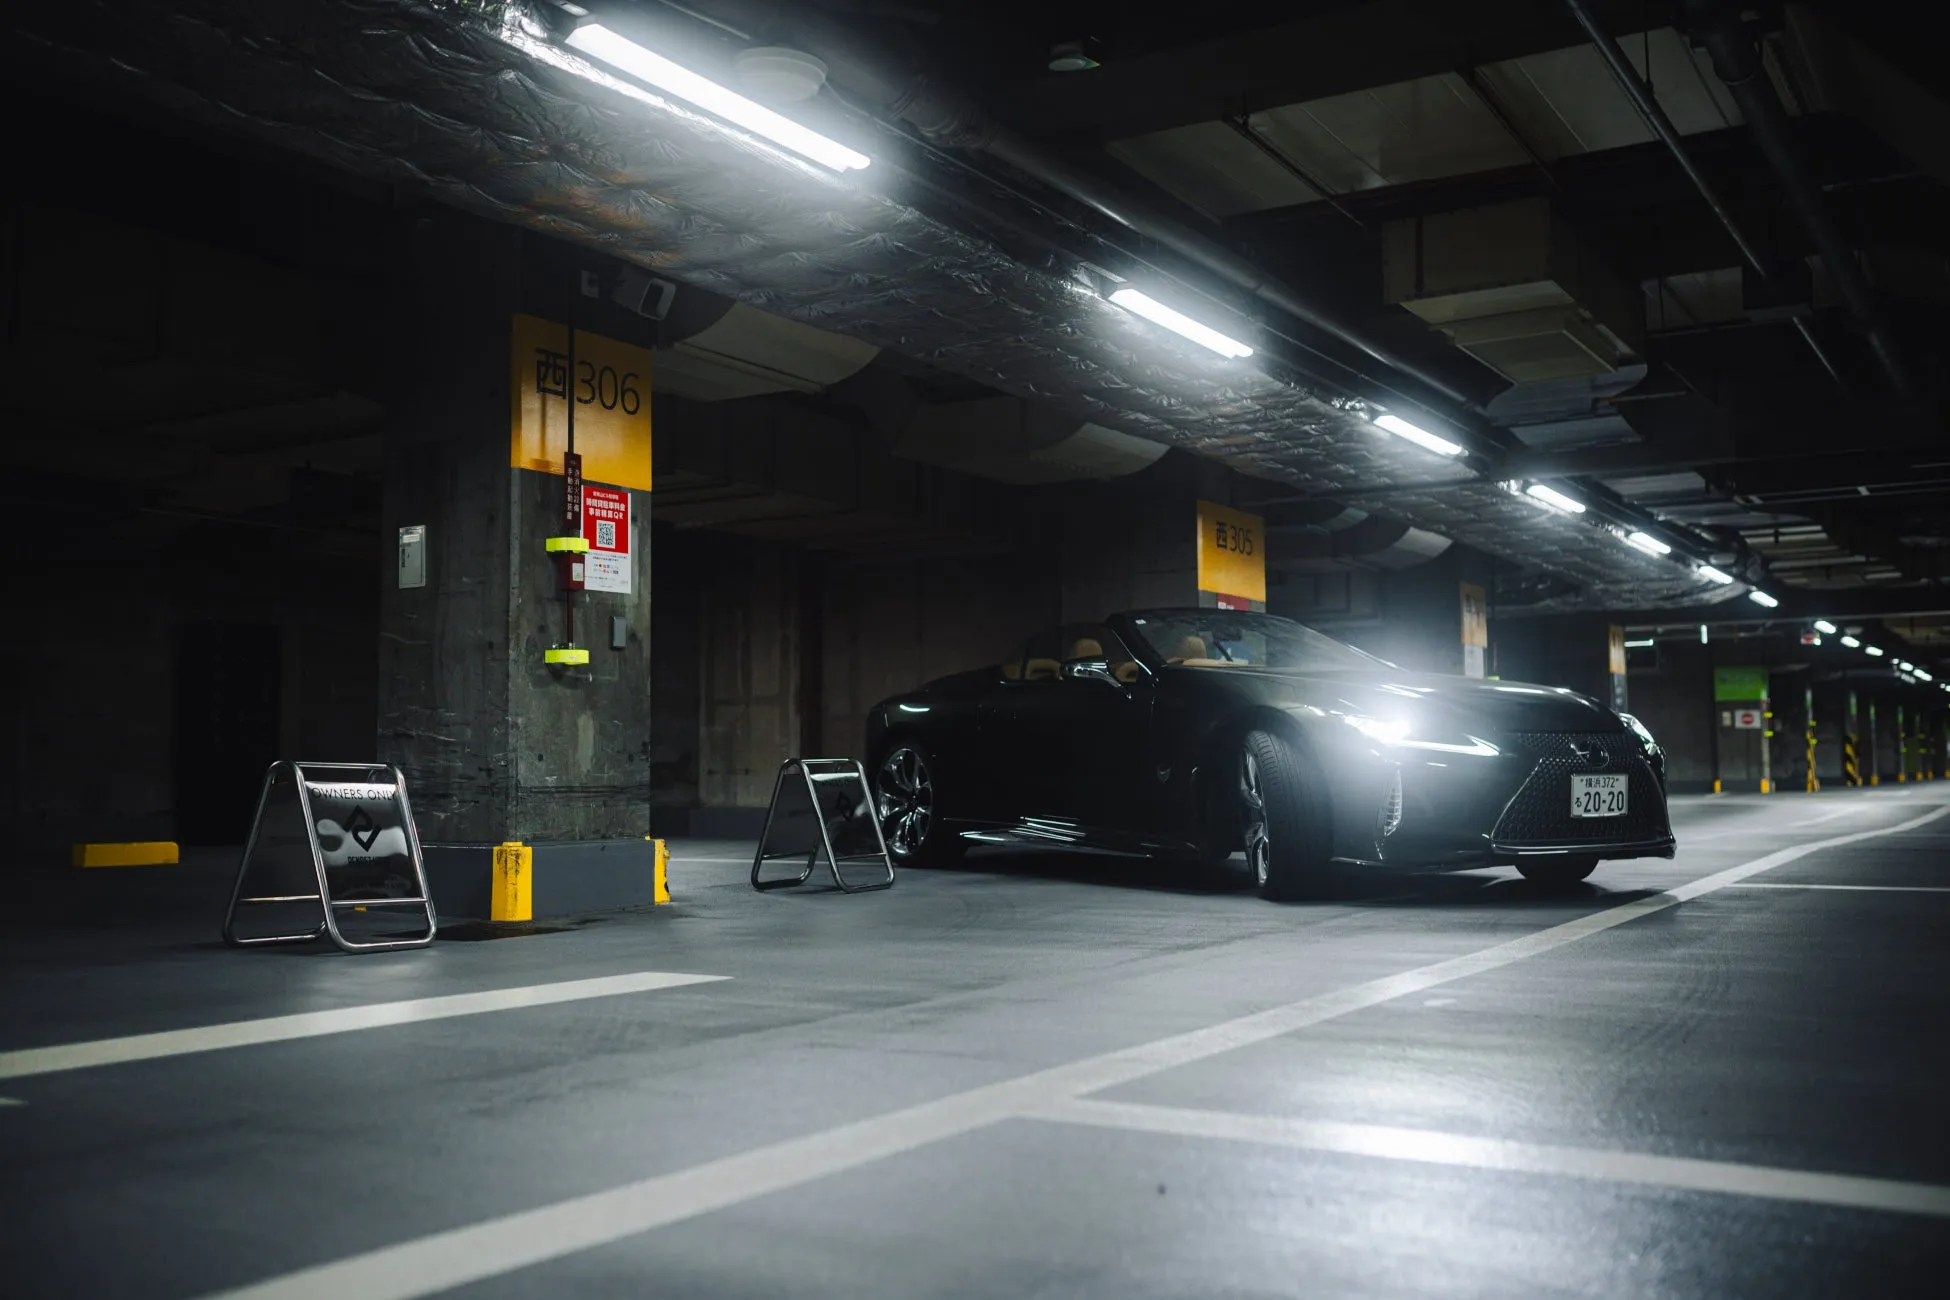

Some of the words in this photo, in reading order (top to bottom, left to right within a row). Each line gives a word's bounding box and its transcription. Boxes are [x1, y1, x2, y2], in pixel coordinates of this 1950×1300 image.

[312, 787, 364, 800] OWNERS
[367, 789, 397, 801] ONLY
[1574, 797, 1583, 808] る
[1583, 791, 1625, 813] 20-20
